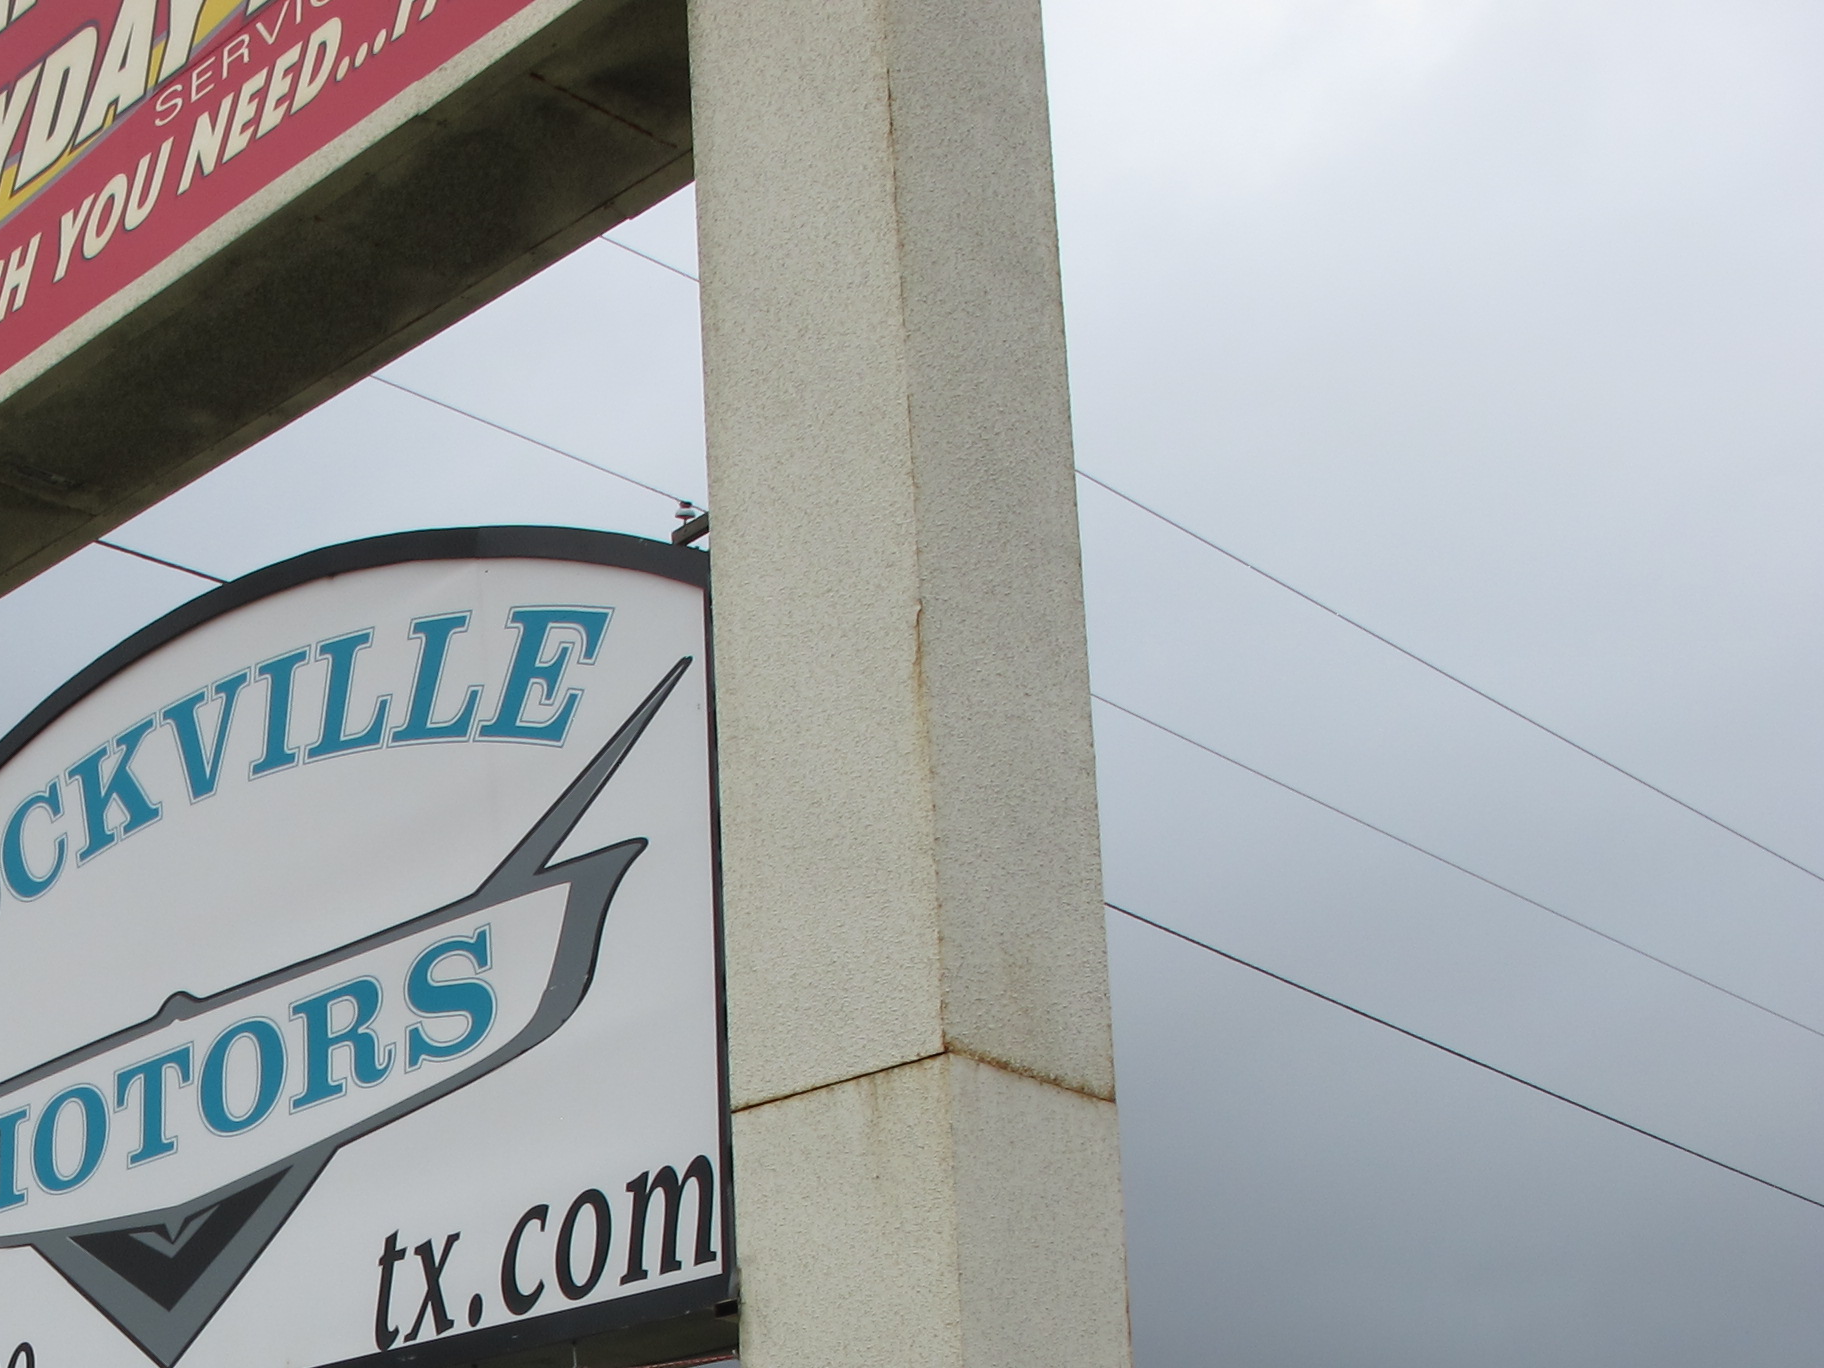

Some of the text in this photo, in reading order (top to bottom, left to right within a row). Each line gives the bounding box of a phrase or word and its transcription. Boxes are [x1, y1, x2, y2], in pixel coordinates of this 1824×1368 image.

[154, 0, 331, 127] SERVI
[53, 136, 175, 283] YOU
[375, 1154, 717, 1351] tx.com
